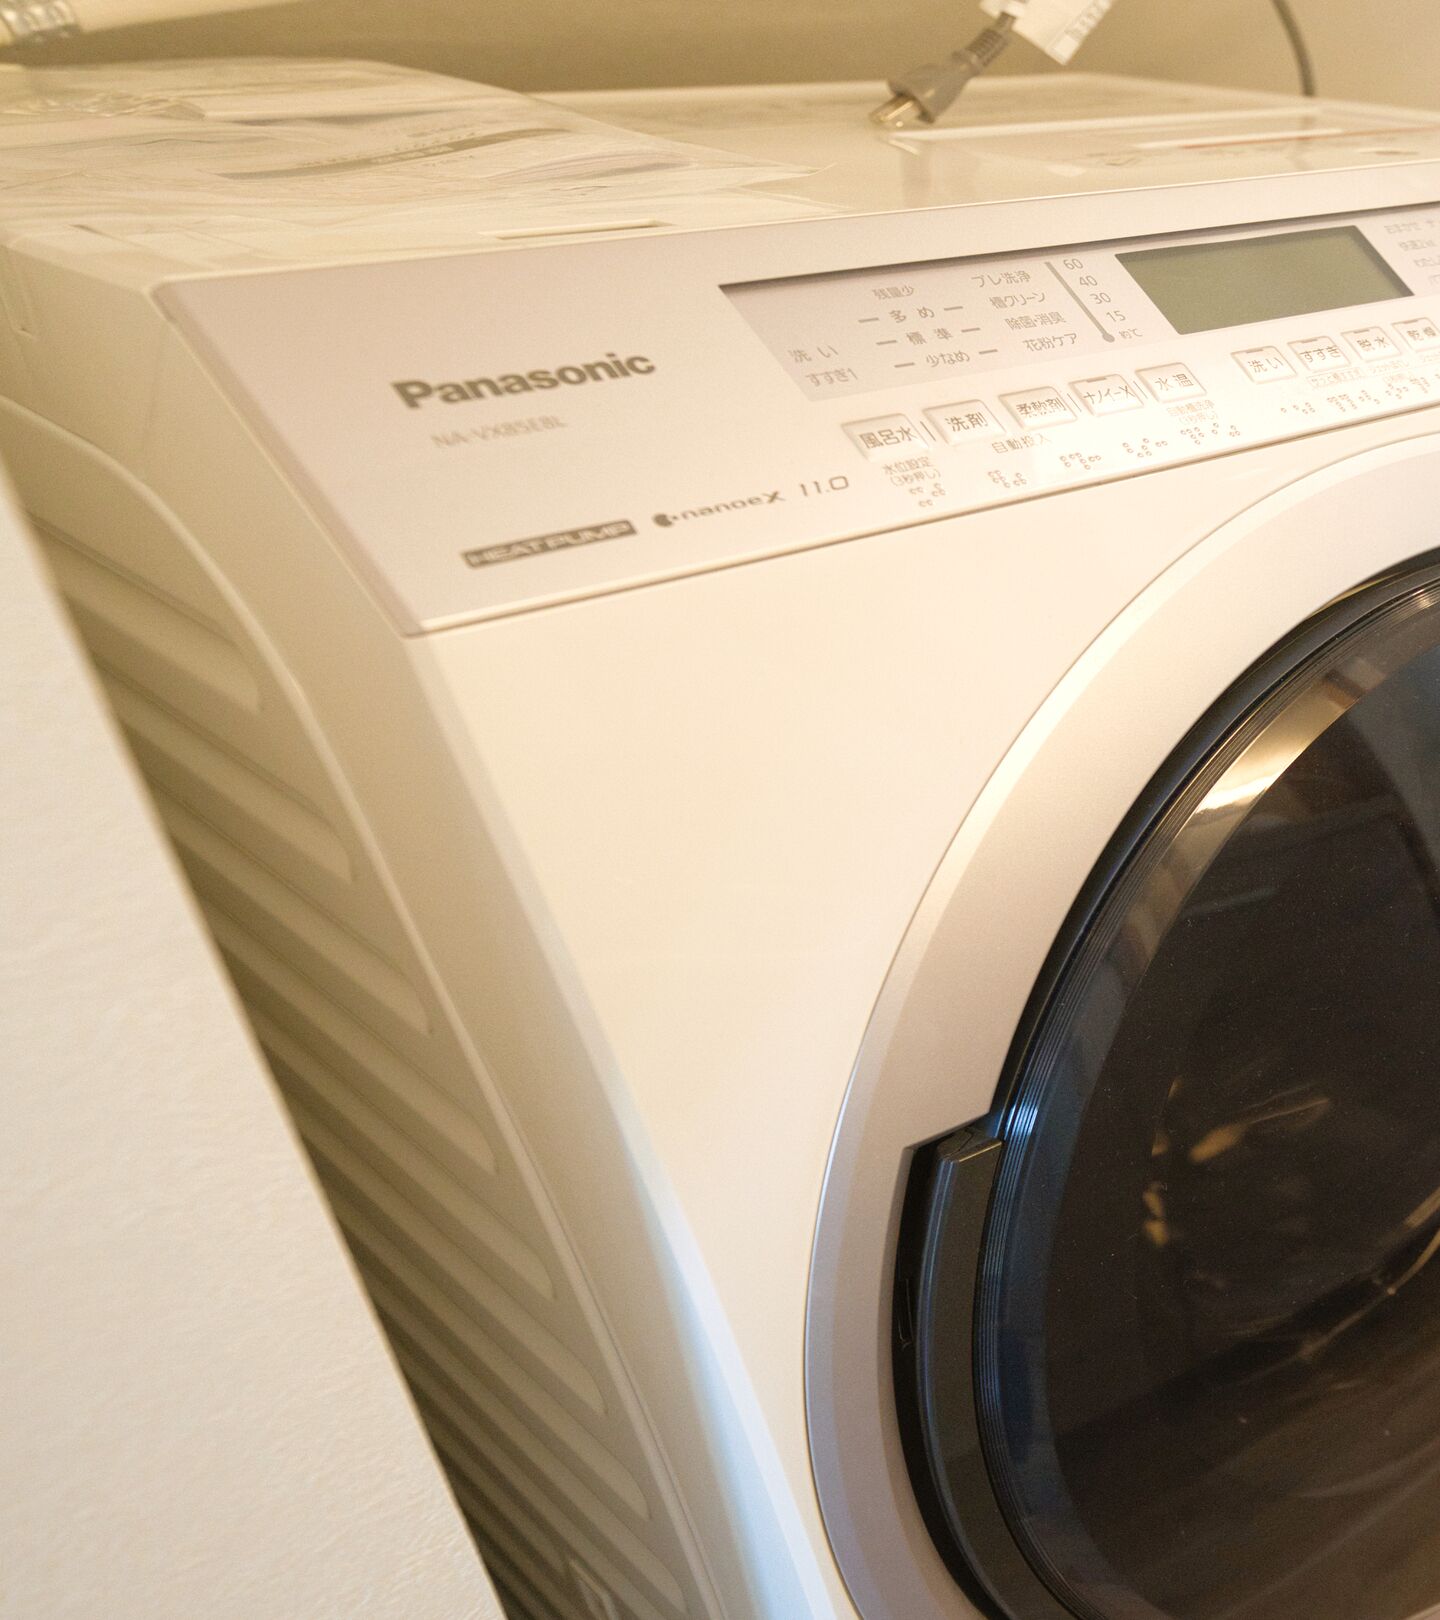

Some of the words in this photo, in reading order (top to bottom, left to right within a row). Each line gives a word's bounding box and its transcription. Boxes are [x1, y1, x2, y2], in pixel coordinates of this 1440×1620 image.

[1063, 257, 1085, 271] 60
[1078, 274, 1099, 288] 40
[1091, 291, 1112, 305] 30
[1106, 310, 1127, 323] 15
[925, 349, 972, 369] 少なめ
[1247, 354, 1285, 375] 洗い
[392, 352, 656, 408] Panasonic
[945, 411, 987, 434] 洗剤
[859, 425, 917, 450] 風呂水
[991, 433, 1051, 455] 自動投入
[799, 475, 851, 498] 11.0
